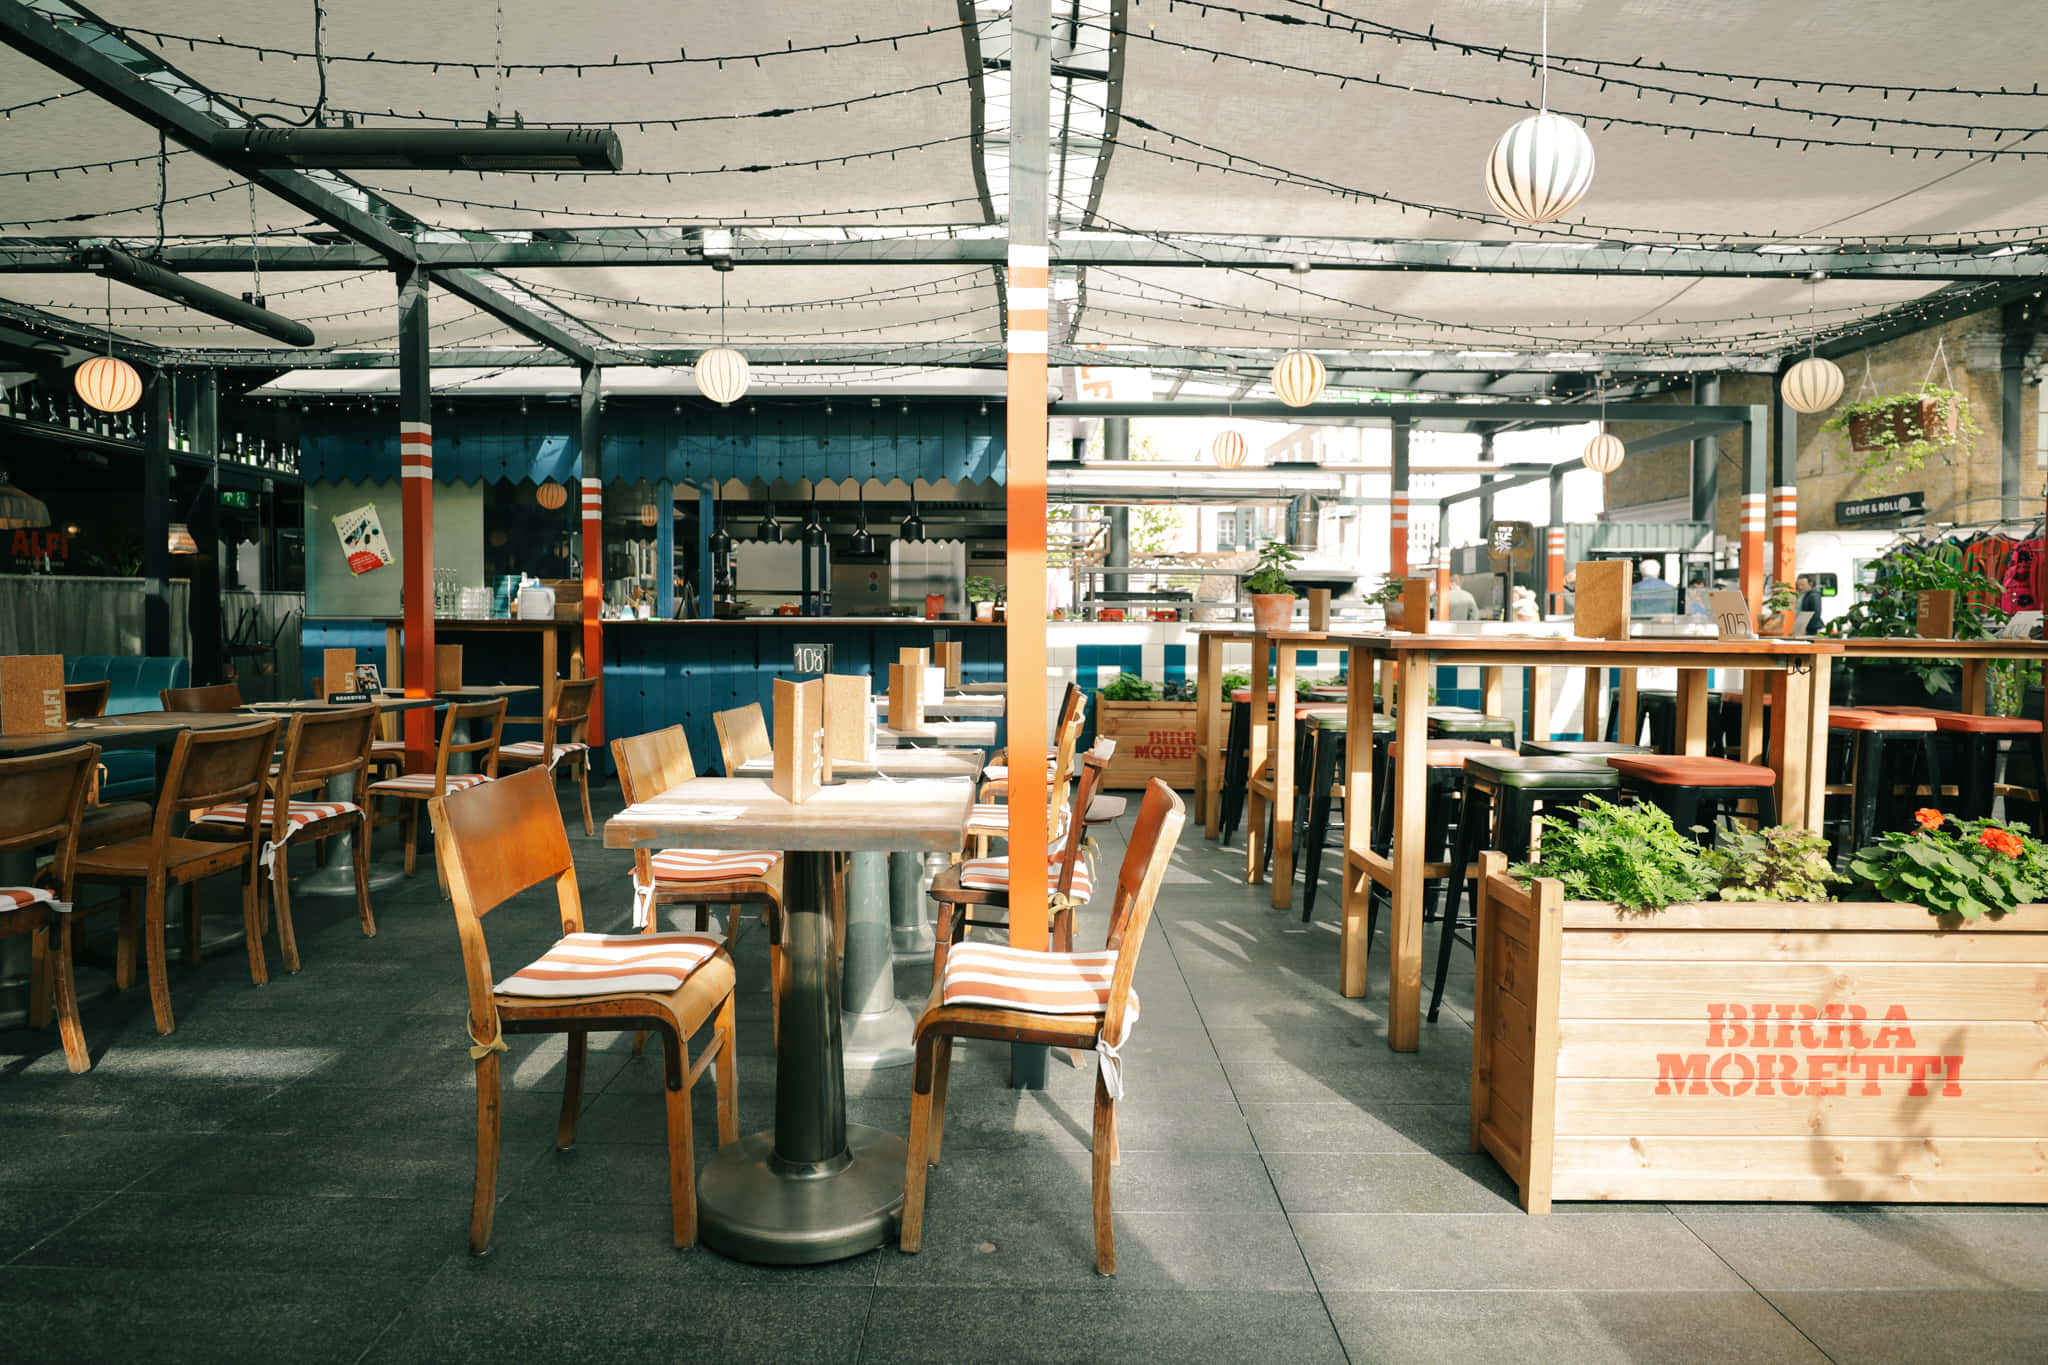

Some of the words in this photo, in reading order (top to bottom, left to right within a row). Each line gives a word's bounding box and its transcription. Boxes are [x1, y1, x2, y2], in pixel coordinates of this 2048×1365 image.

[1845, 504, 1870, 517] CREPE
[1871, 503, 1878, 513] &
[11, 529, 68, 559] ALFI
[1718, 611, 1748, 635] 105
[794, 647, 824, 673] 108
[43, 689, 63, 728] ALFI
[1705, 1003, 1917, 1049] BIRRA
[1655, 1052, 1964, 1097] MORETTI
